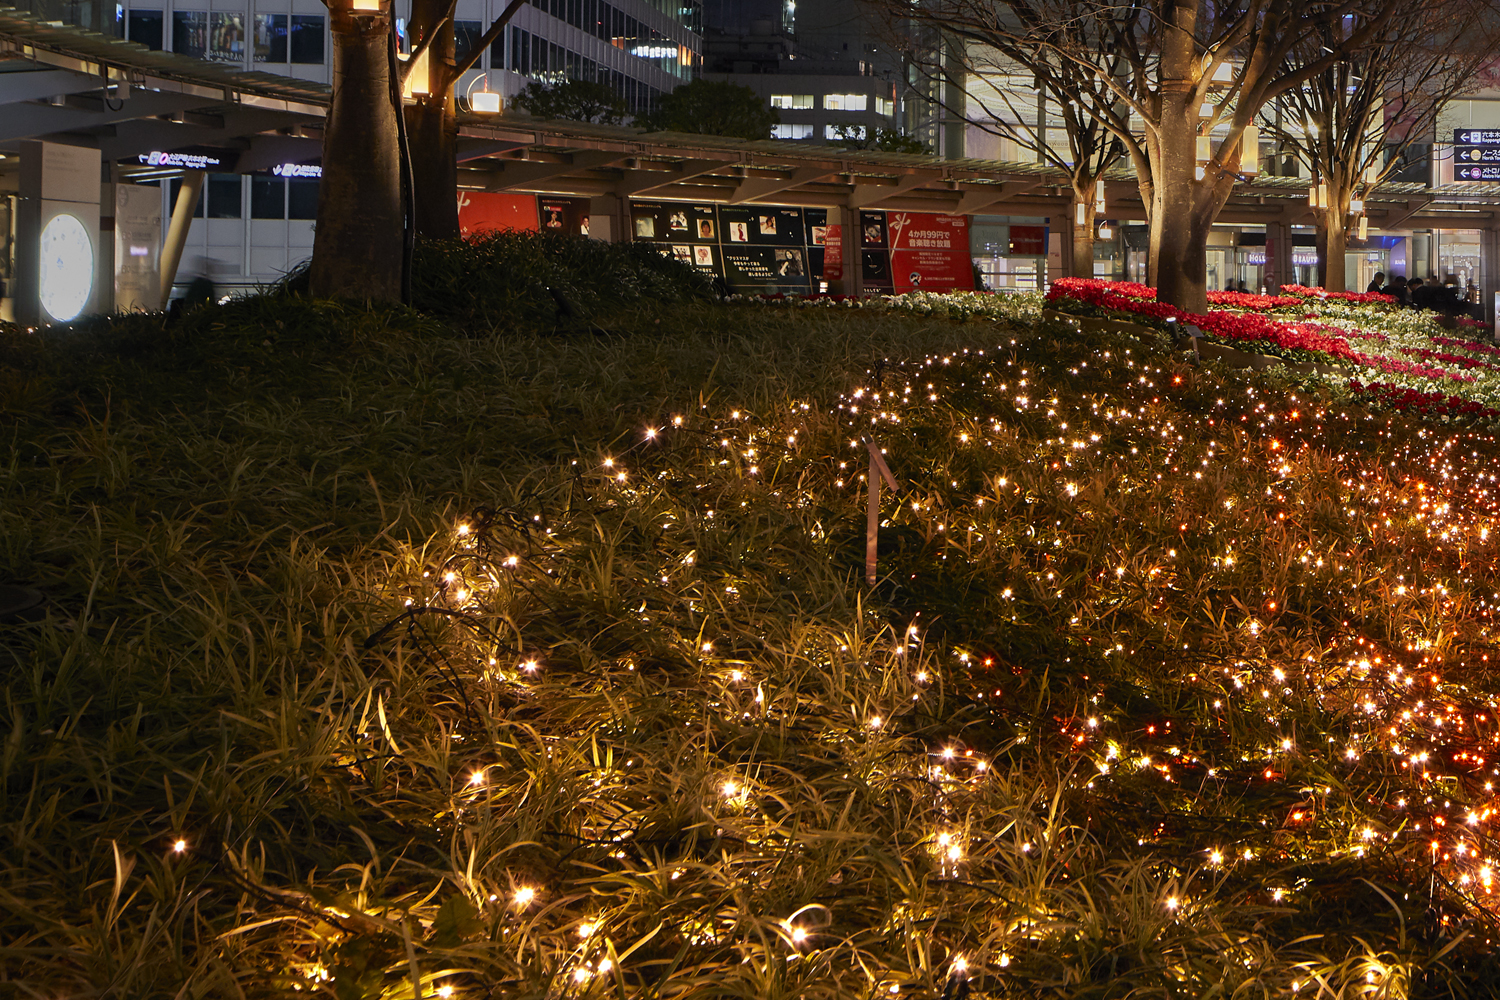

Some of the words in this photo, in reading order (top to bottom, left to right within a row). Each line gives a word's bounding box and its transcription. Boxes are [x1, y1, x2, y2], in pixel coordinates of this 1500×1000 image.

[908, 229, 950, 239] 4か月99円で
[1249, 254, 1266, 263] HOLL
